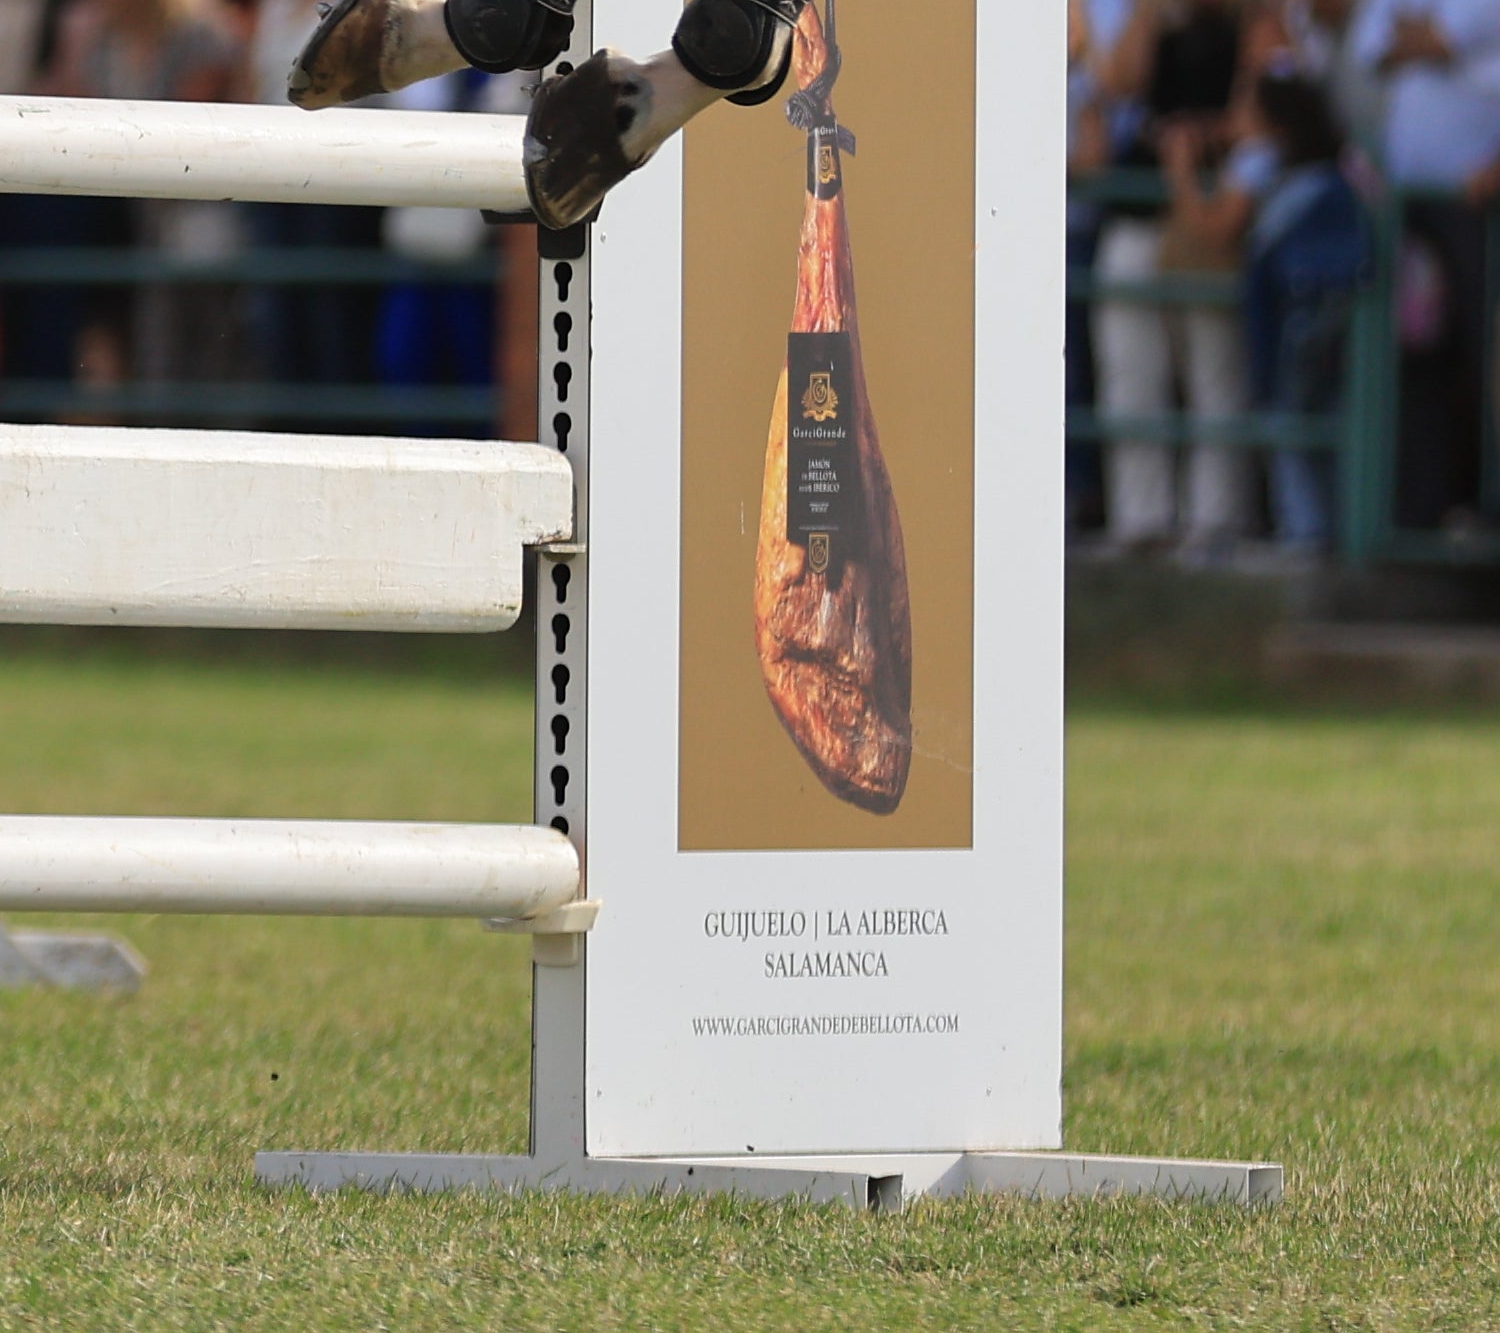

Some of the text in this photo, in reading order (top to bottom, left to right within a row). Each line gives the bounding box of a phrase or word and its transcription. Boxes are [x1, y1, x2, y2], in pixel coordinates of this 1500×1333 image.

[703, 910, 807, 943] GUIJUELO
[827, 910, 851, 937] LA
[857, 909, 949, 936] ALBERCA
[763, 950, 889, 980] SALAMANCA
[691, 1013, 961, 1038] WWW.GARCIGRANDEDEBELLOTA.COM
